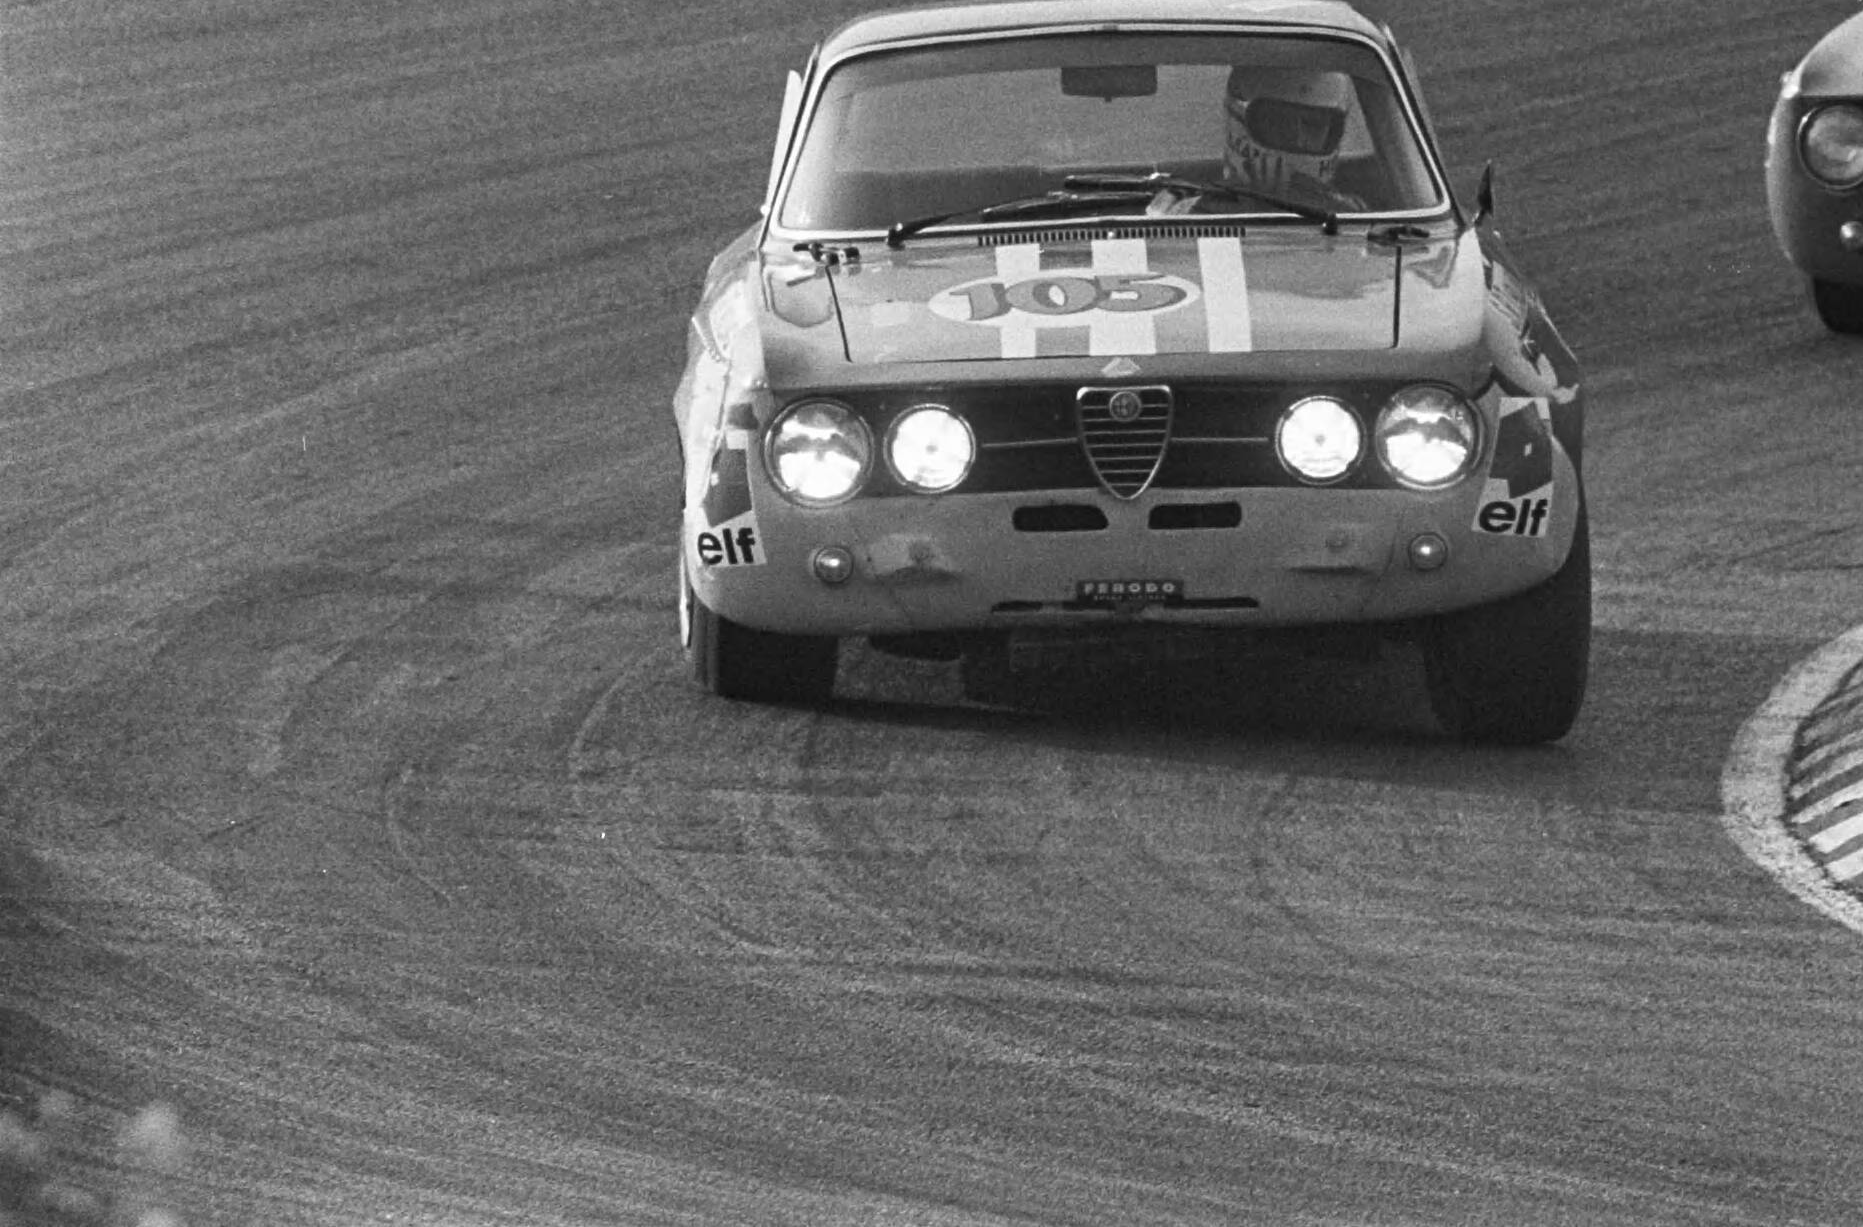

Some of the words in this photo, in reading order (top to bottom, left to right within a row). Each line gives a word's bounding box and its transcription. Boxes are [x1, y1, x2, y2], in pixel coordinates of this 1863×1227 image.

[950, 274, 1188, 321] 105
[1479, 499, 1548, 536] elf
[698, 527, 755, 565] elf
[1084, 582, 1175, 595] FERODO
